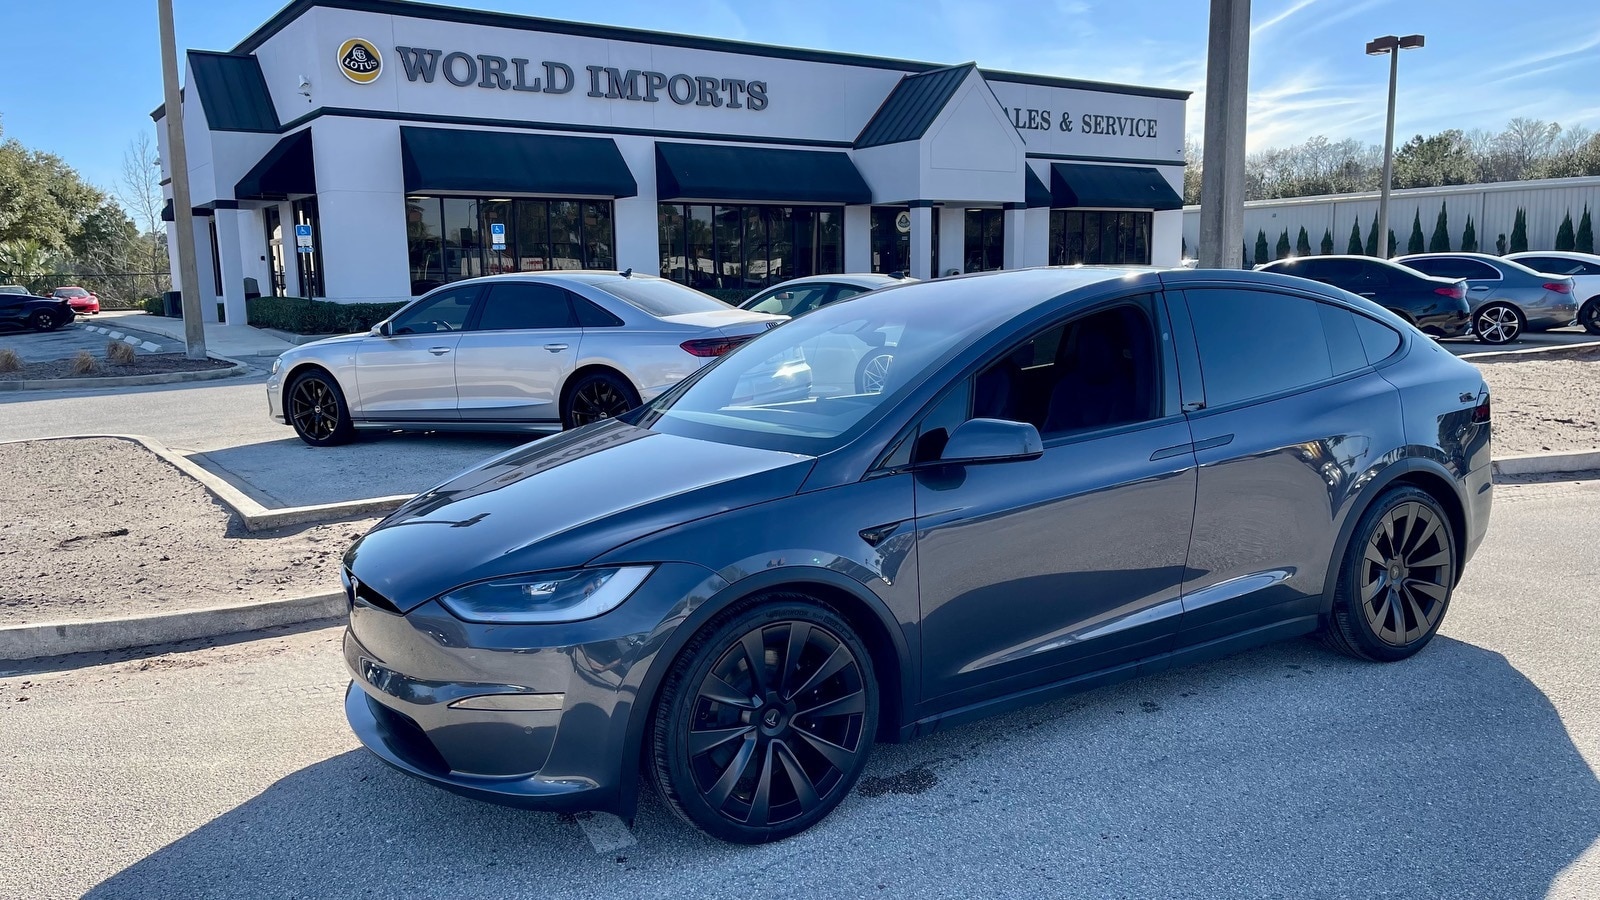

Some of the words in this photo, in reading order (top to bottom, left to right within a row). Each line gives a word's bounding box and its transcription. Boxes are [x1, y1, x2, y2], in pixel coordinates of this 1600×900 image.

[344, 58, 378, 70] LOTUS
[395, 45, 575, 94] WORLD
[586, 65, 769, 111] IMPORTS
[1060, 111, 1073, 132] &
[1081, 113, 1158, 138] SERVICE
